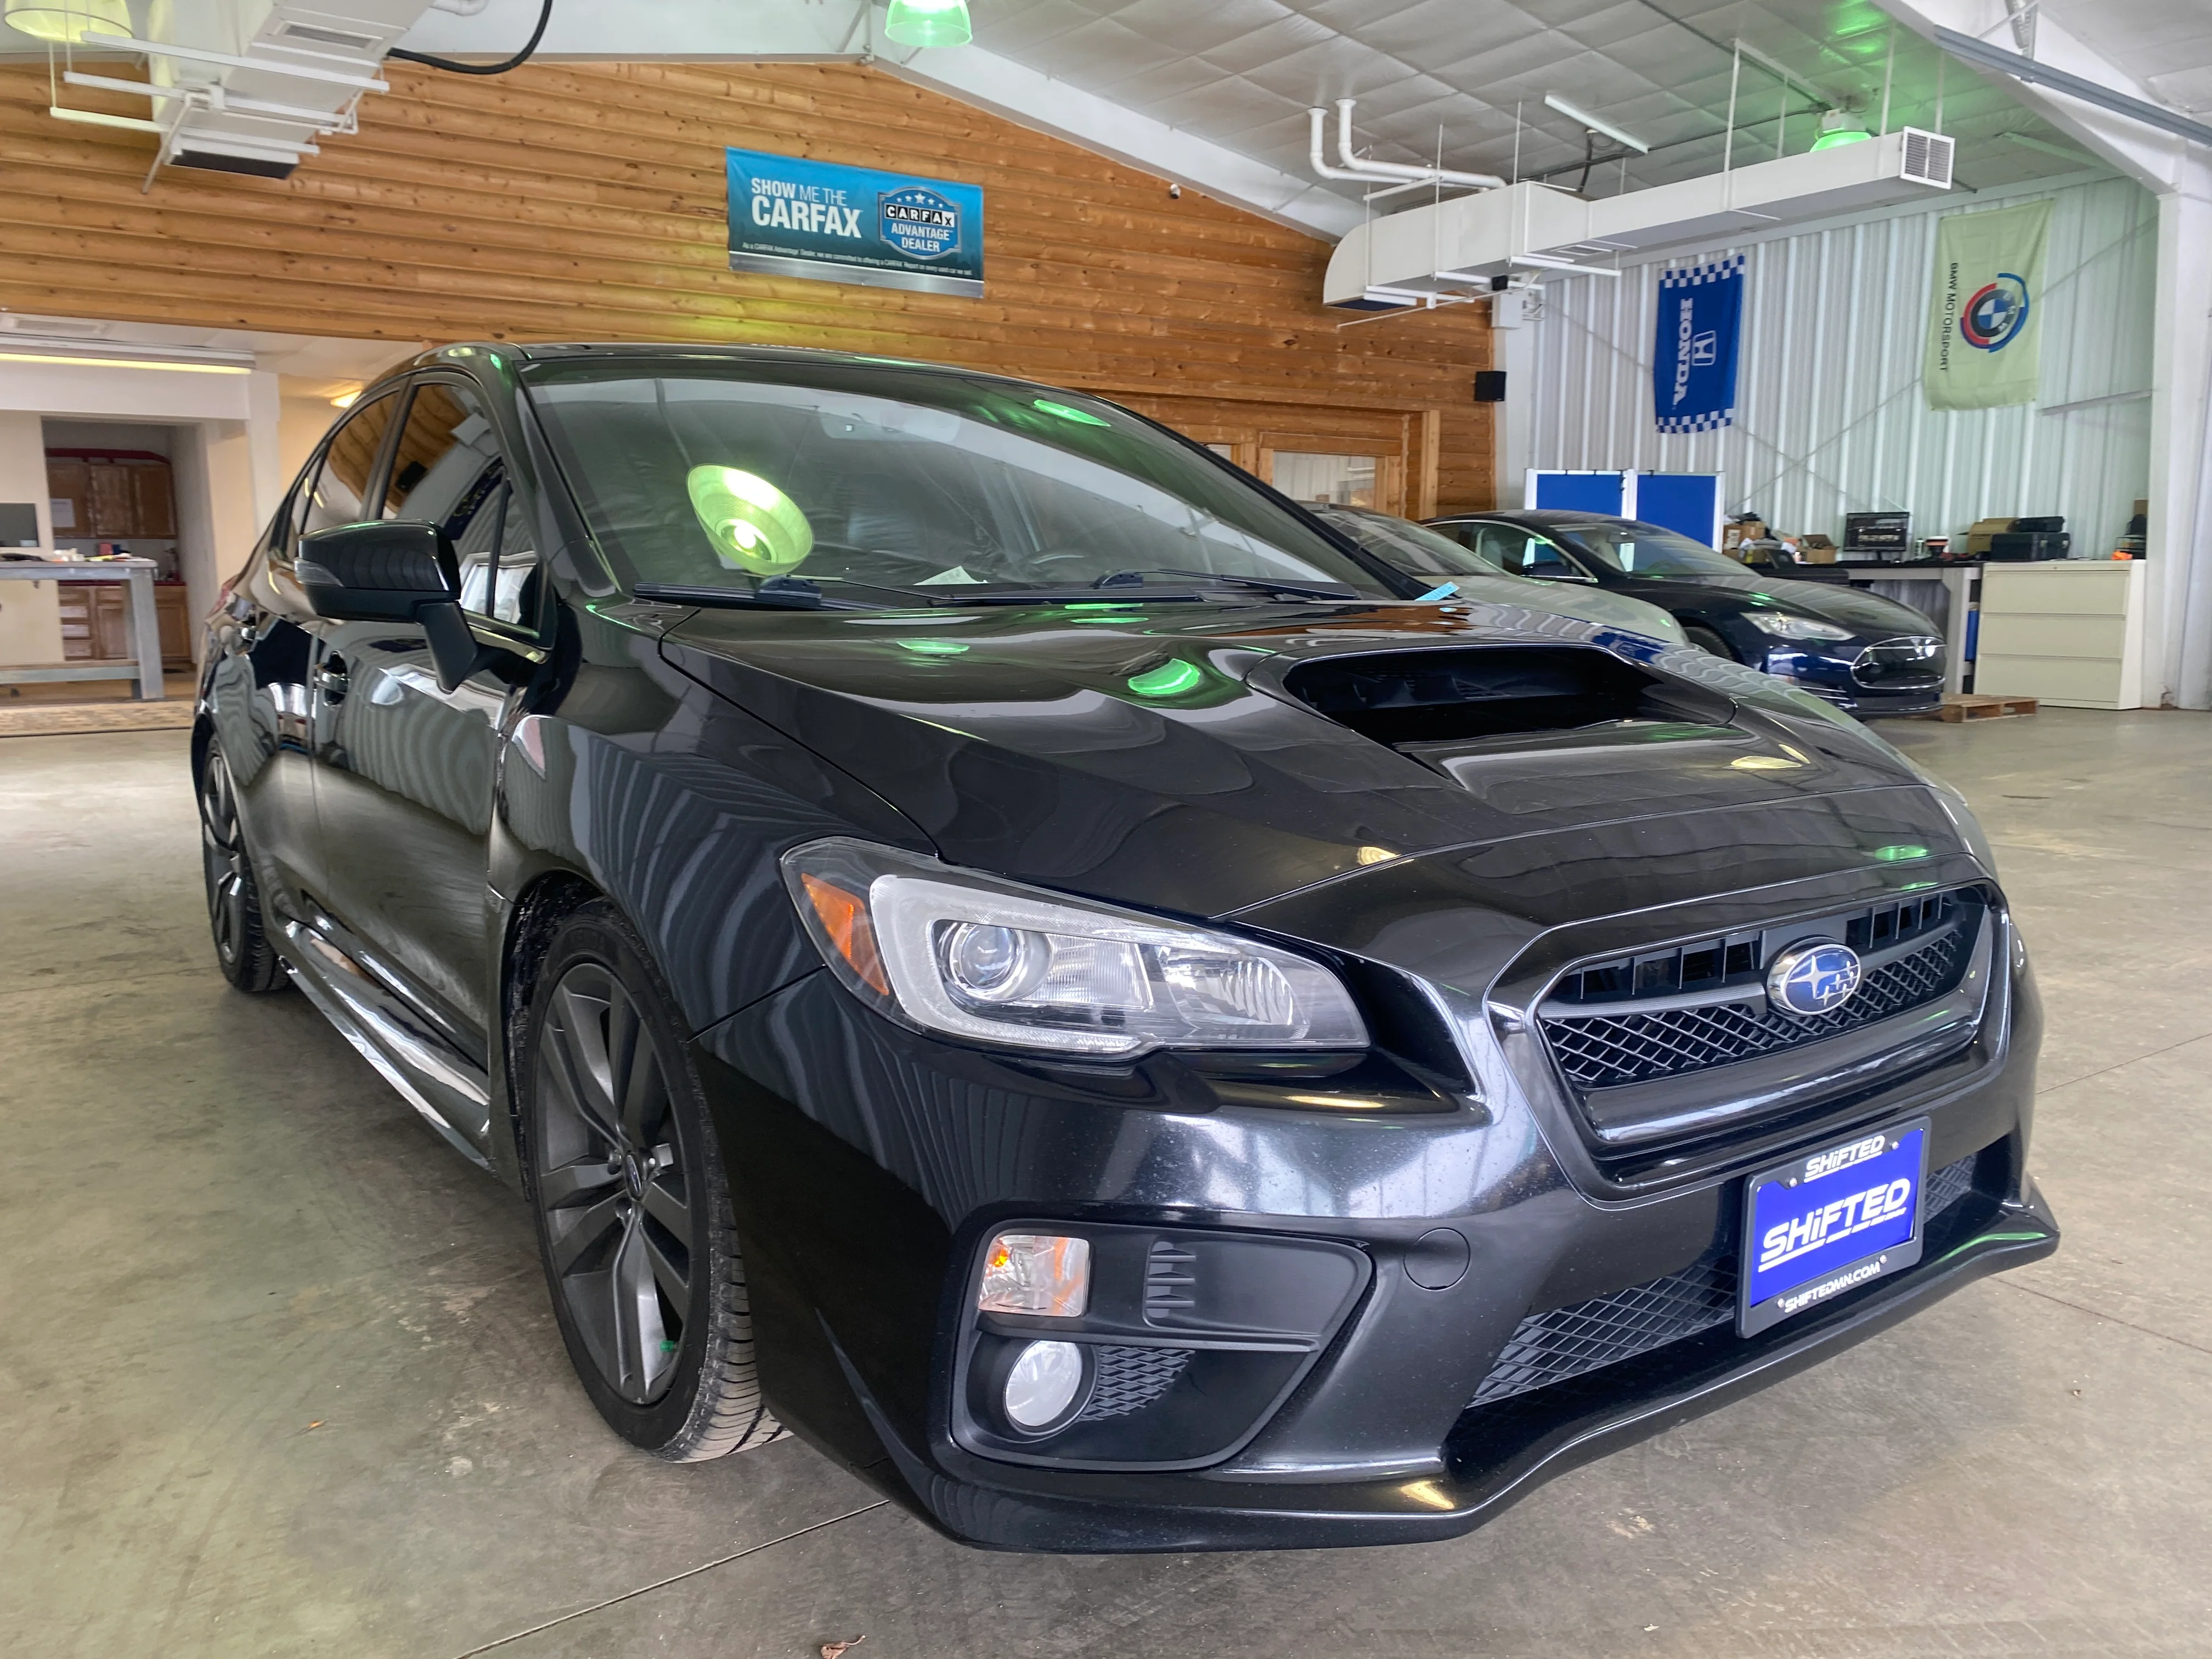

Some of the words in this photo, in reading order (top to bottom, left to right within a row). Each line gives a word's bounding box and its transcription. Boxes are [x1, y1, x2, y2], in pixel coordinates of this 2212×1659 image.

[751, 177, 796, 199] SHOW
[799, 184, 820, 202] ME
[822, 188, 848, 206] THE
[752, 195, 862, 238] CARFAX
[887, 206, 952, 227] CARFAX
[891, 223, 950, 240] ADVANTAGE
[901, 236, 940, 252] DEALER
[1948, 262, 1959, 290] BMW
[1939, 293, 1957, 372] MOTORSPORT
[1673, 298, 1694, 409] HONDA
[1785, 1261, 1881, 1313] SHIFTEDMN.COM
